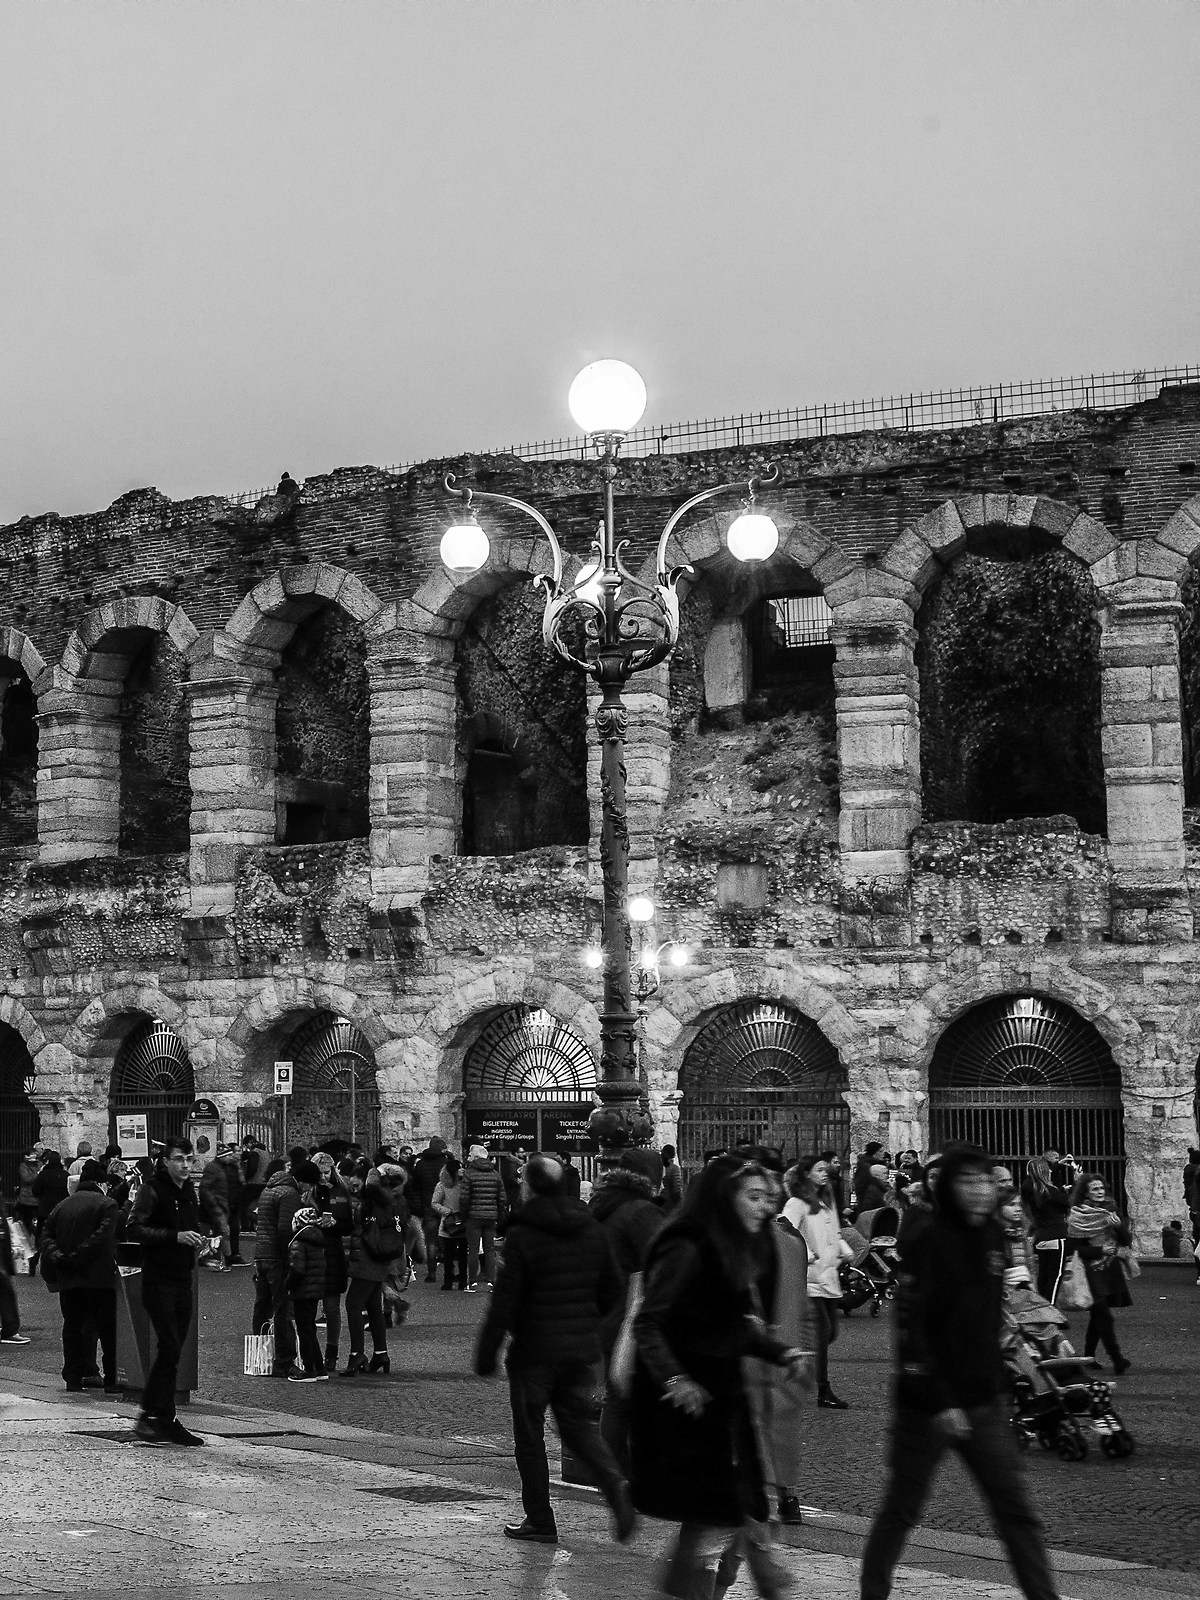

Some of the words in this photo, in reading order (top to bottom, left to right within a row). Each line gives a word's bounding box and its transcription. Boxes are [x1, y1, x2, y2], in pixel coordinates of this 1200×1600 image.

[484, 1111, 535, 1119] ANFITEATRO
[543, 1111, 573, 1119] ARENA
[555, 1133, 572, 1141] Singoli
